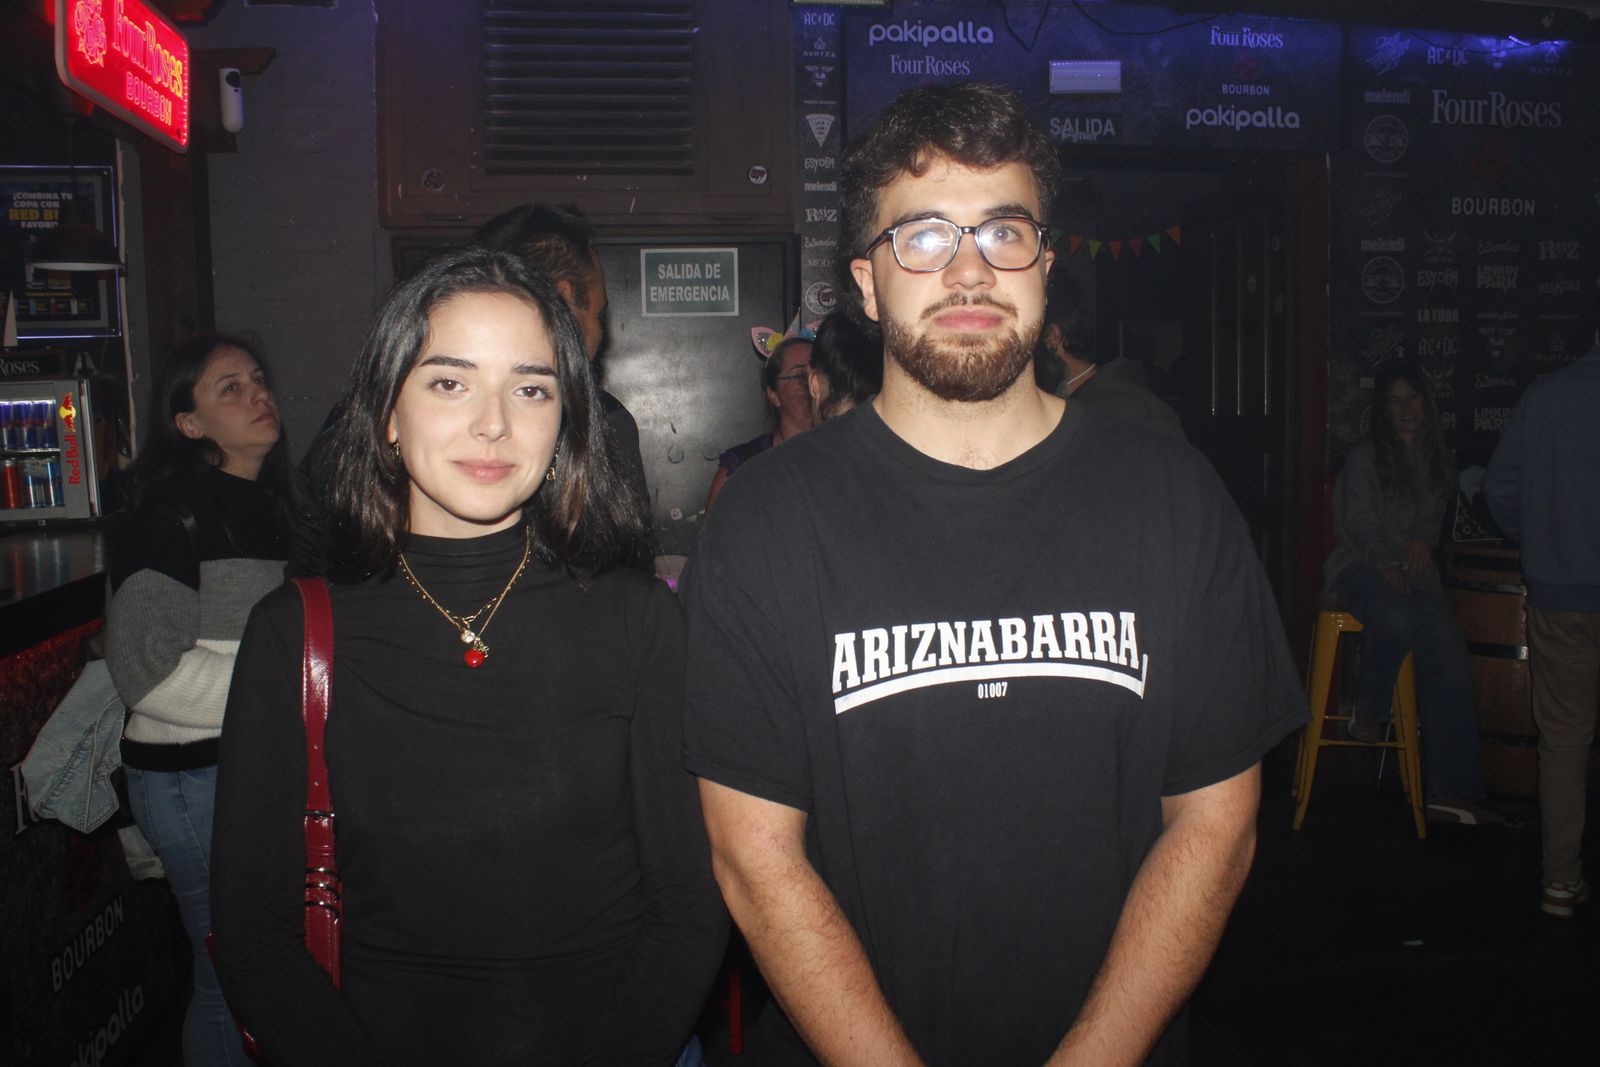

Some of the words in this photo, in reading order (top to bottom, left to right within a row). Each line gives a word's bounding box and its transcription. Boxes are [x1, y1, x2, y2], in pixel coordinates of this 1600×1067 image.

[869, 20, 994, 48] pakipalla
[126, 71, 173, 126] BOURBON
[1222, 83, 1270, 96] BOURBON
[1050, 117, 1117, 137] SALIDA
[1186, 104, 1300, 132] pakipalla
[13, 201, 39, 209] COPA
[41, 201, 60, 209] CON
[1451, 197, 1536, 217] BOURBON
[8, 208, 40, 221] RED
[658, 263, 702, 279] SALIDA
[705, 263, 721, 279] DE
[1477, 264, 1519, 275] LINKIN
[1477, 275, 1519, 293] PARK
[650, 285, 730, 302] EMERGENCIA
[1417, 308, 1431, 322] LA
[1432, 308, 1460, 323] FUGA
[832, 611, 1139, 694] ARIZNABARRA
[978, 682, 1008, 699] 01007
[51, 894, 125, 993] BOURBON
[70, 984, 144, 1067] kipalla
